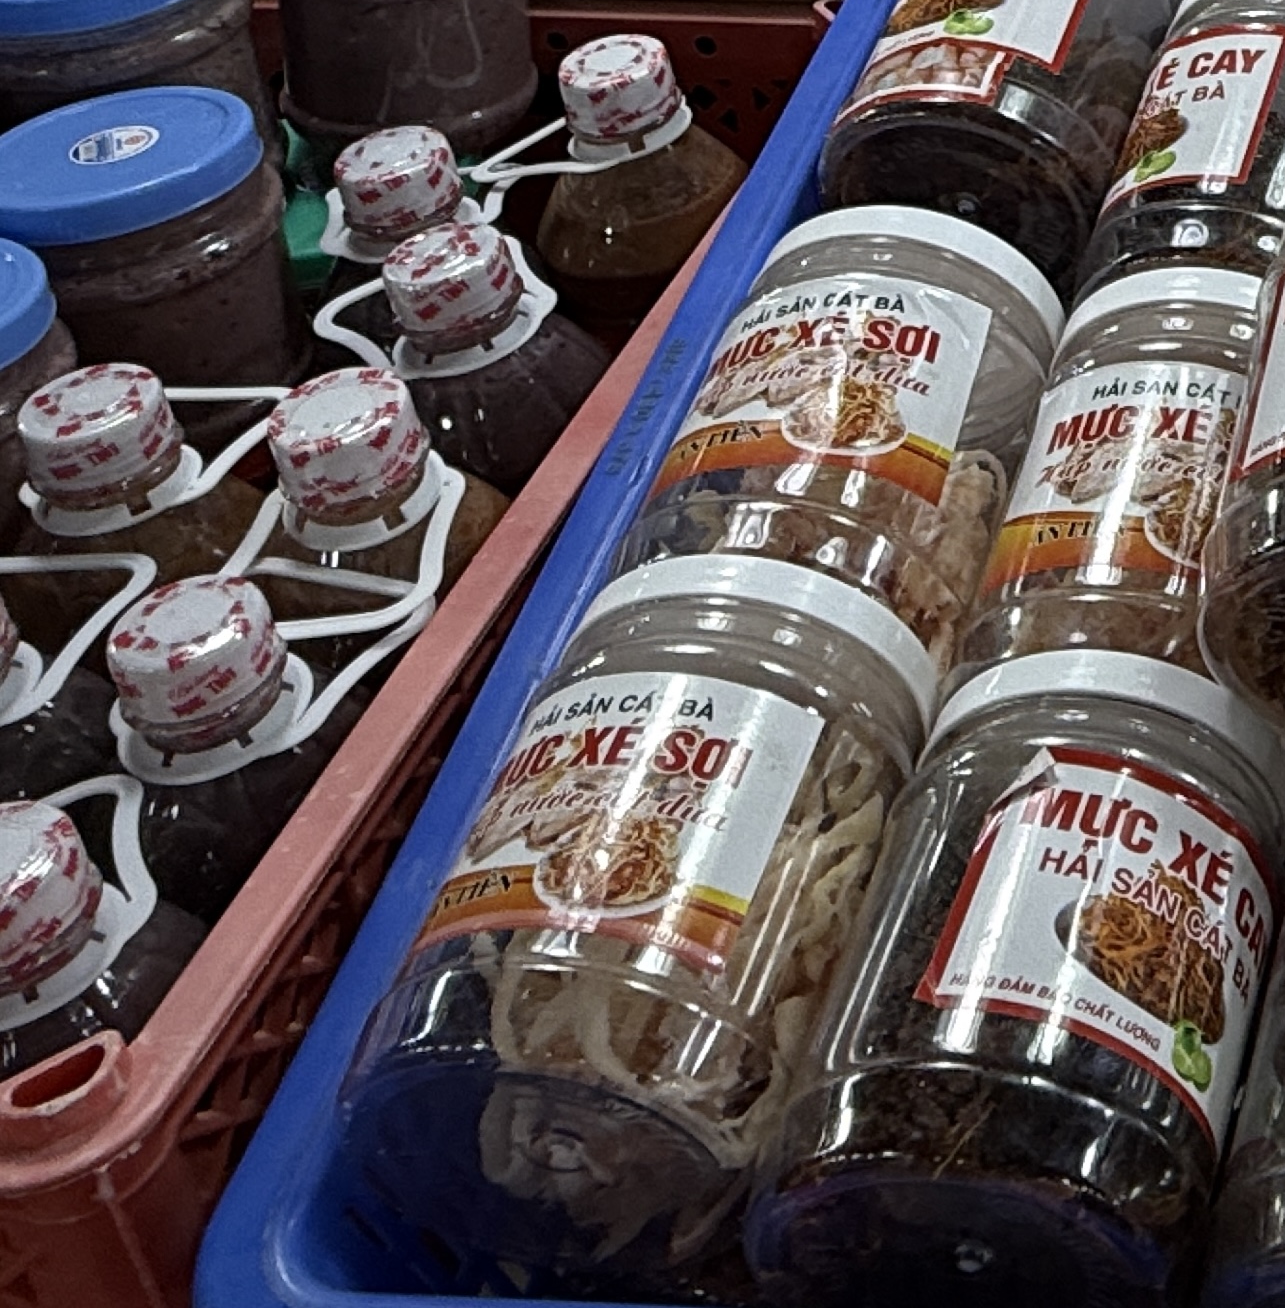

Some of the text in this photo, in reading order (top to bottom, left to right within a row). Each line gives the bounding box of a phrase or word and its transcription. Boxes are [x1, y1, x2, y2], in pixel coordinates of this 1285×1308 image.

[1187, 48, 1266, 80] CAY
[1191, 80, 1225, 103] BÀ
[775, 291, 905, 320] SẢN CÁT BÀ
[863, 319, 941, 364] SỢI
[1092, 378, 1126, 400] HẢI
[1186, 381, 1232, 405] CÁT
[1046, 404, 1210, 456] MỰC XÉ
[564, 693, 714, 722] SẢN BÀ
[567, 718, 754, 790] XÉ SỢI
[1021, 788, 1235, 904] MỰC XÉ
[1039, 838, 1180, 926] HẢI SẢN
[999, 973, 1161, 1052] ĐẢM CHẤT LƯỢNG
